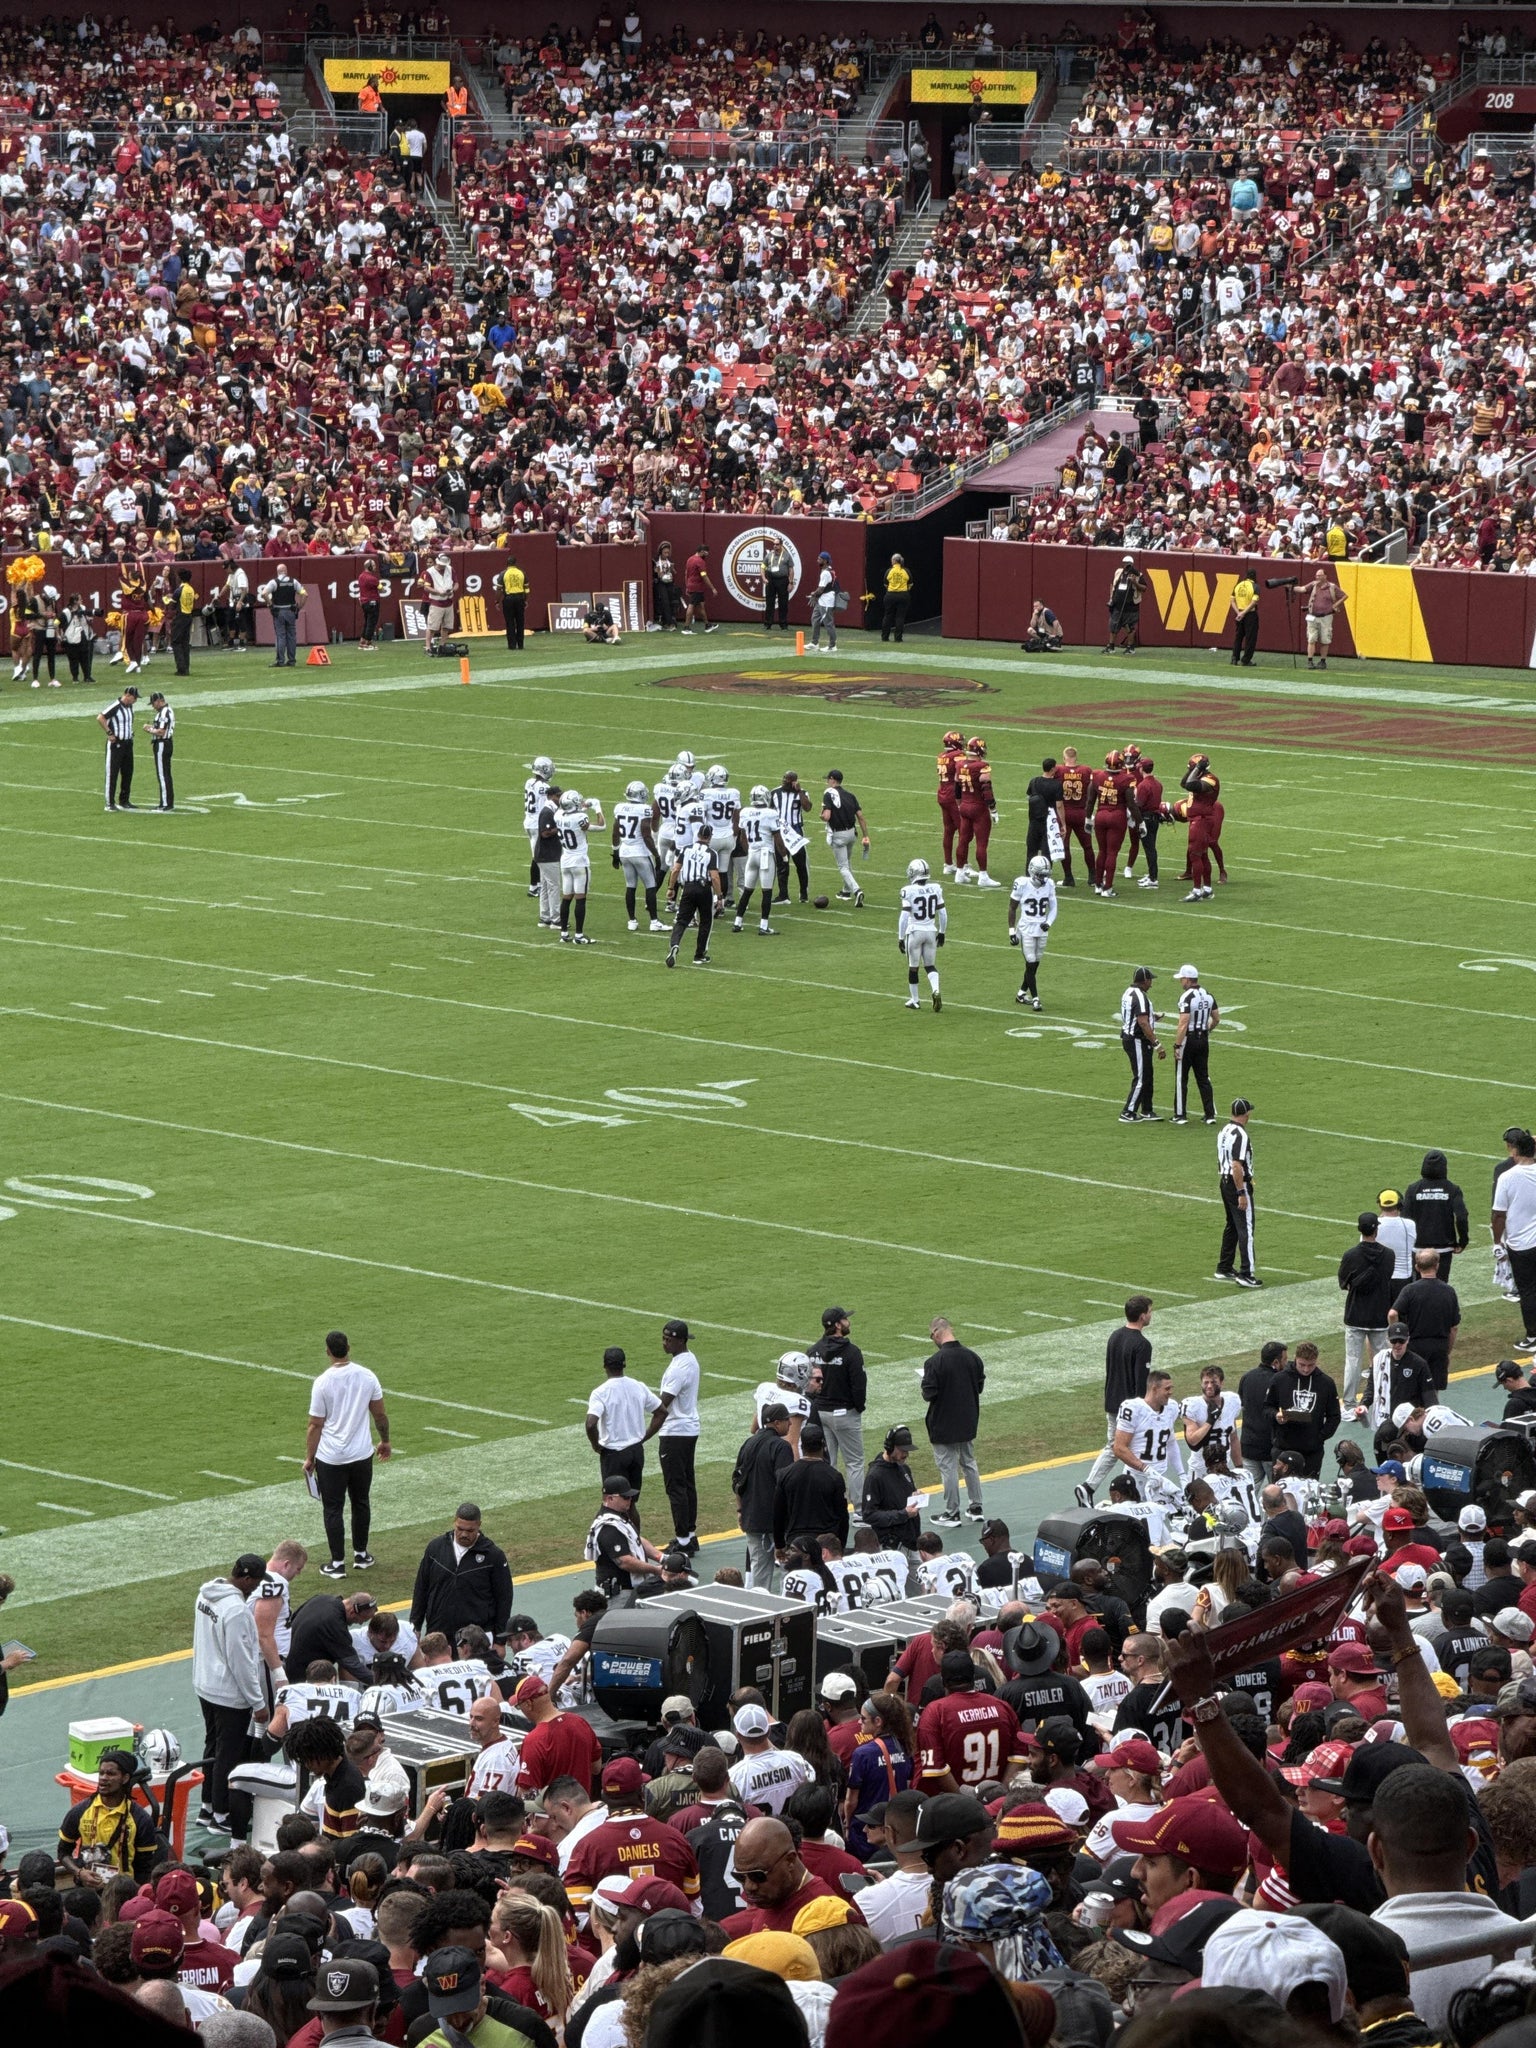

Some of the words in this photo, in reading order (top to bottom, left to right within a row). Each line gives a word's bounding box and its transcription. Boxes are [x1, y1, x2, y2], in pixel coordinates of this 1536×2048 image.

[343, 72, 380, 80] MARYLAND
[397, 73, 428, 81] LOTTERY
[984, 83, 1014, 91] LOTTERY
[1485, 93, 1515, 109] 208
[642, 150, 654, 162] 12
[792, 247, 802, 259] 21
[1225, 287, 1232, 298] 5
[1108, 343, 1120, 354] 17
[1077, 369, 1094, 384] 24
[120, 448, 132, 461] 21
[558, 450, 569, 462] 21
[582, 461, 594, 474] 21
[680, 463, 691, 477] 99
[120, 496, 136, 510] 52
[238, 503, 249, 513] 89
[369, 499, 383, 511] 28
[523, 510, 534, 522] 91
[728, 529, 767, 555] WASHINGTON
[769, 531, 796, 558] FOOTBALL
[746, 549, 760, 558] 19
[629, 582, 638, 631] WASHINGTON
[1147, 569, 1239, 634] W
[404, 605, 418, 635] DOWN
[559, 607, 578, 618] GET
[555, 618, 585, 629] LOUD!
[319, 649, 329, 662] G
[1063, 780, 1083, 801] 63
[691, 807, 703, 816] 45
[711, 801, 735, 820] 96
[618, 816, 639, 839] 57
[747, 819, 762, 842] 11
[913, 895, 938, 920] 30
[1198, 1001, 1209, 1010] 83
[1416, 1193, 1449, 1201] RAIDERS
[1117, 1406, 1133, 1422] 18
[1425, 1416, 1443, 1434] 15
[1140, 1428, 1171, 1461] 18
[1436, 1465, 1464, 1477] POWER
[870, 1553, 893, 1564] WHITE
[1043, 1550, 1066, 1562] POWER
[261, 1584, 284, 1598] 67
[784, 1576, 808, 1595] 80
[744, 1631, 772, 1646] FIELD
[1229, 1641, 1248, 1655] OF
[1248, 1613, 1309, 1650] AMERICA
[433, 1663, 473, 1676] MEREDITH
[609, 1668, 651, 1676] BREEZER
[611, 1661, 652, 1671] POWER
[1235, 1672, 1267, 1688] BOWERS
[316, 1686, 344, 1699] MILLER
[437, 1679, 478, 1714] 61
[1024, 1687, 1064, 1707] STABLER
[1097, 1681, 1130, 1700] TAYLOR
[958, 1705, 999, 1723] KERRIGAN
[1153, 1717, 1183, 1756] 34
[920, 1749, 935, 1766] 91
[962, 1729, 1000, 1783] 91
[483, 1772, 504, 1791] 17
[750, 1768, 792, 1791] JACKSON
[617, 1843, 660, 1863] DANIELS
[177, 1966, 219, 1985] ERRIGAN
[437, 1973, 459, 1991] W
